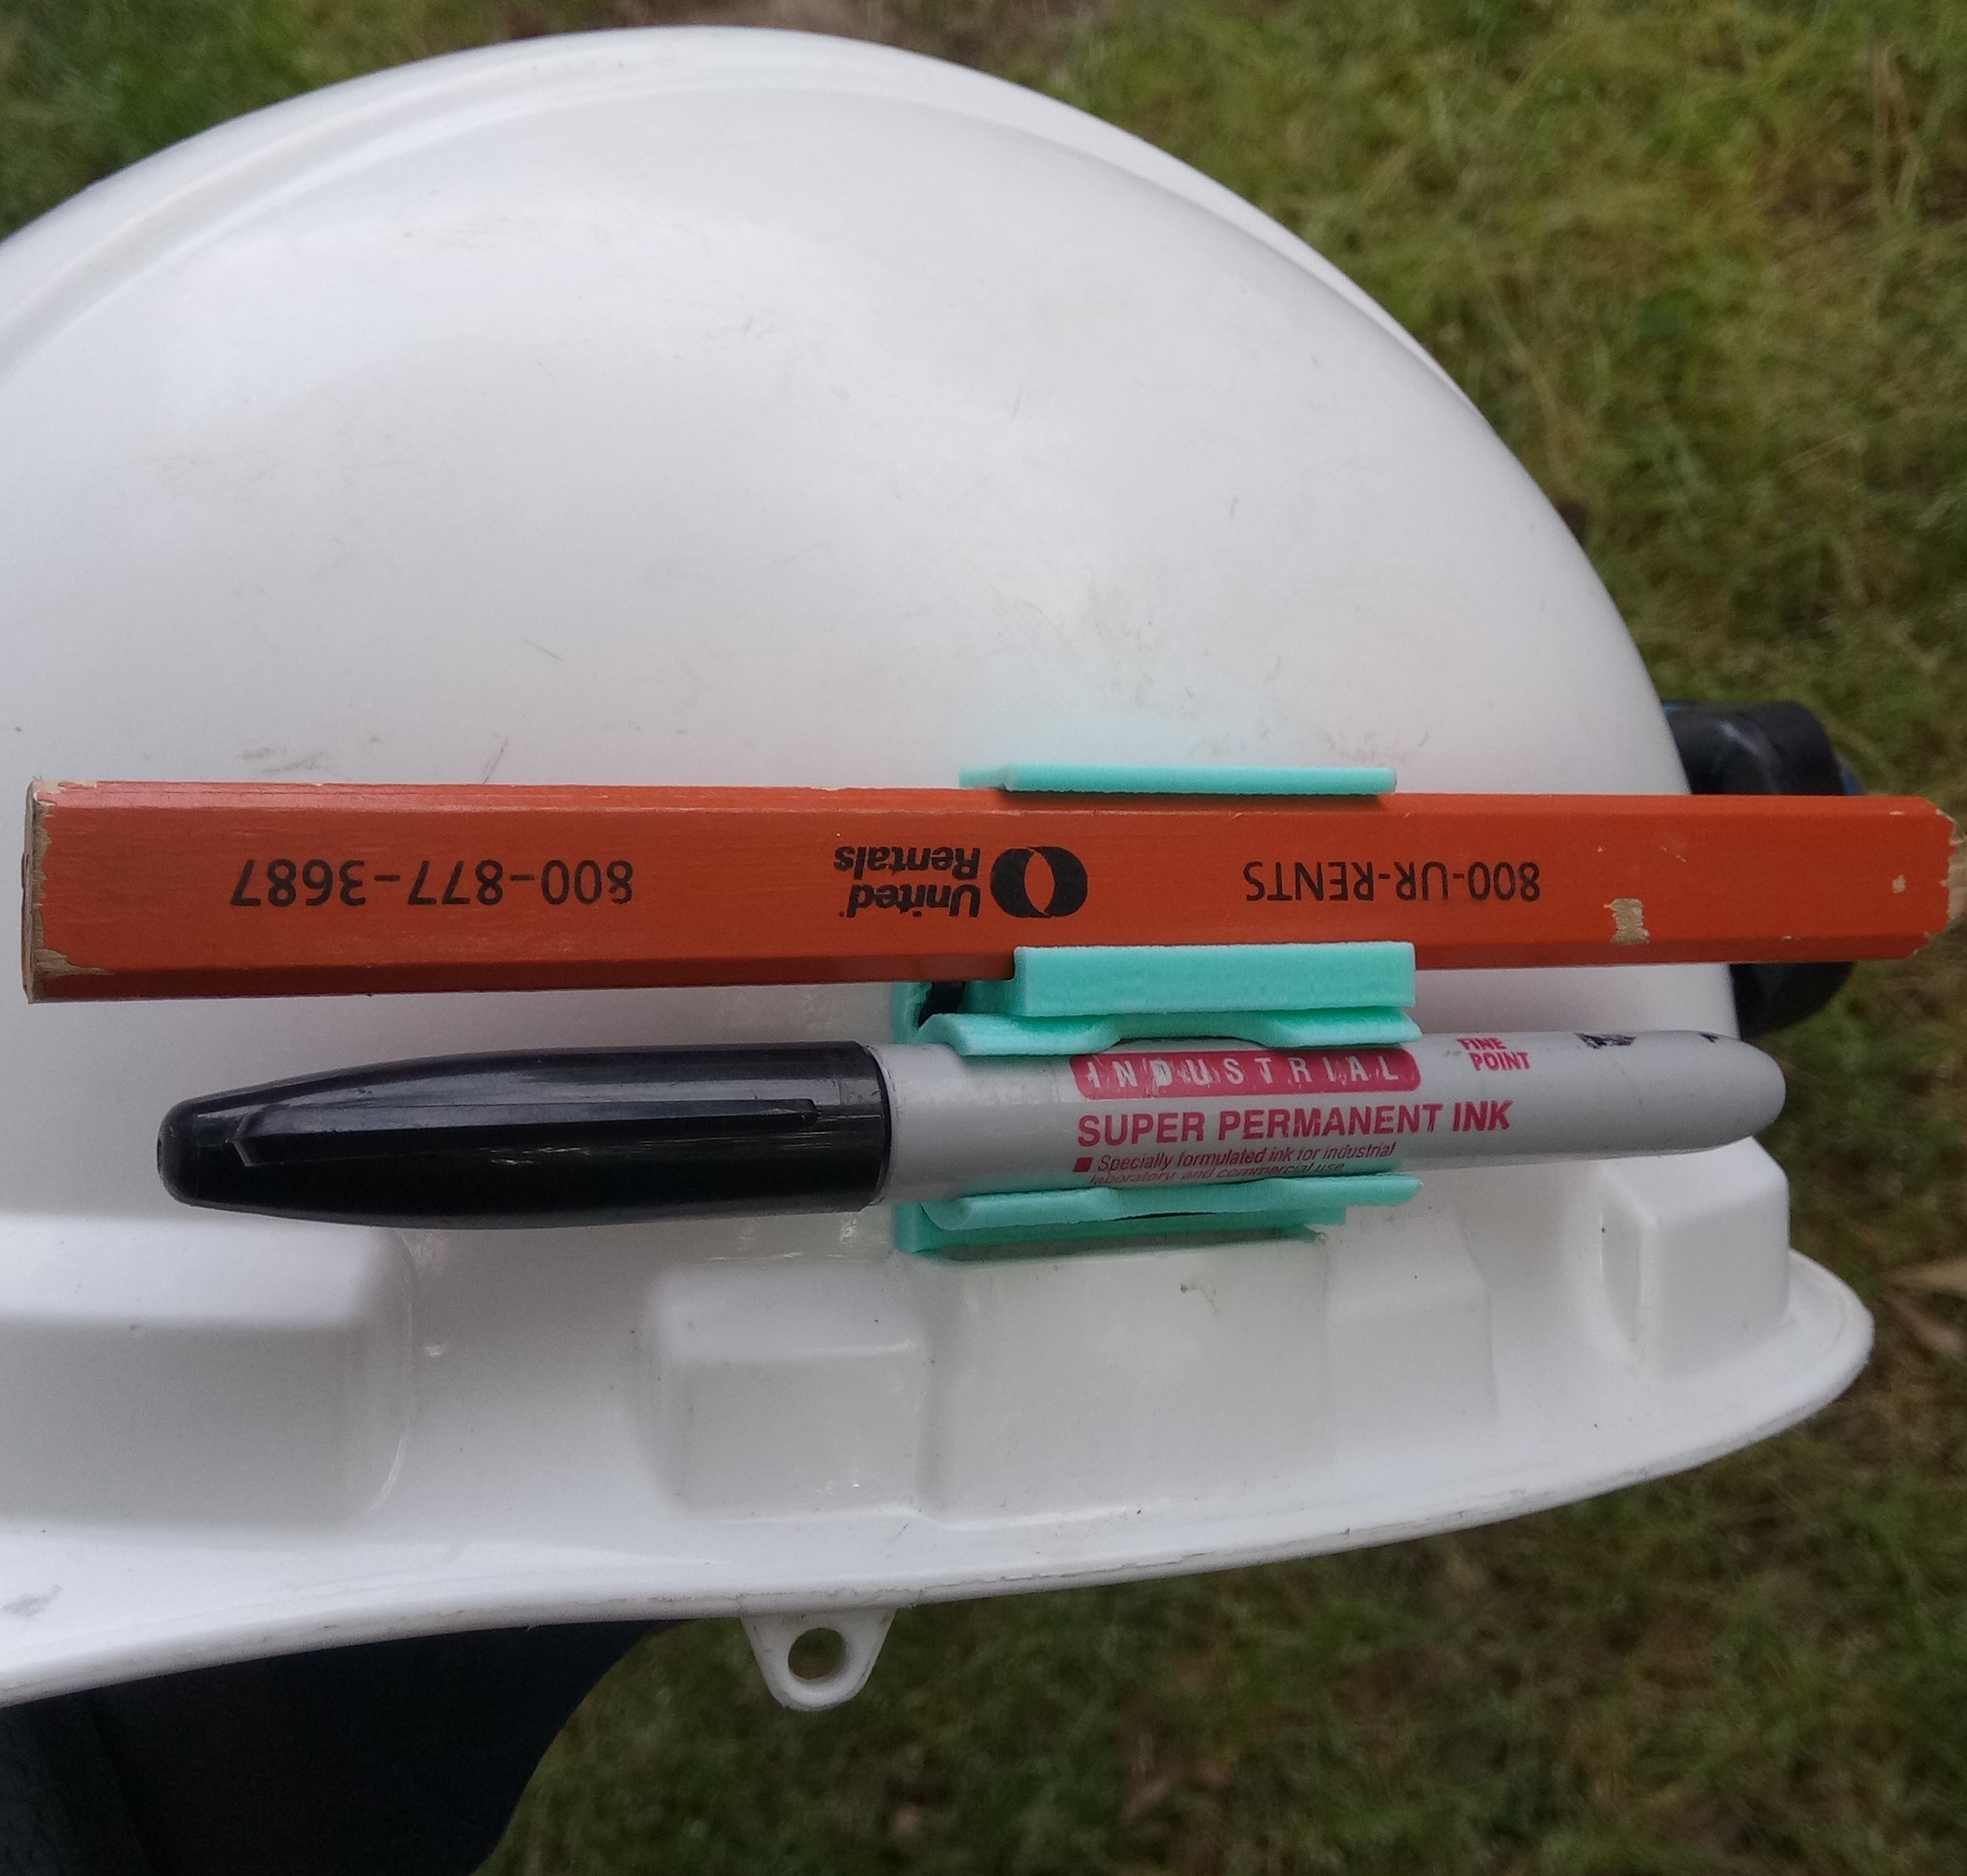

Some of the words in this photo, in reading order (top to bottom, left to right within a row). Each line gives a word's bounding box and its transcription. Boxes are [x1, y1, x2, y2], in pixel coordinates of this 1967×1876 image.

[833, 846, 981, 880] Rentals
[230, 859, 634, 907] 800-877-3687
[1243, 861, 1541, 903] 800-UR-RENTS
[846, 883, 981, 918] United
[1456, 1037, 1507, 1051] FINE
[1469, 1051, 1530, 1071] POINT
[1085, 1055, 1400, 1090] INDUSTRIAL
[1077, 1112, 1206, 1147] SUPER
[1218, 1103, 1443, 1142] PERMANENT
[1452, 1100, 1514, 1132] INK
[1097, 1151, 1174, 1173] Specially
[1178, 1147, 1267, 1166] formulated
[1268, 1146, 1294, 1163] ink
[1295, 1145, 1321, 1161] for
[1180, 1167, 1216, 1180] and
[1215, 1163, 1314, 1179] commercial
